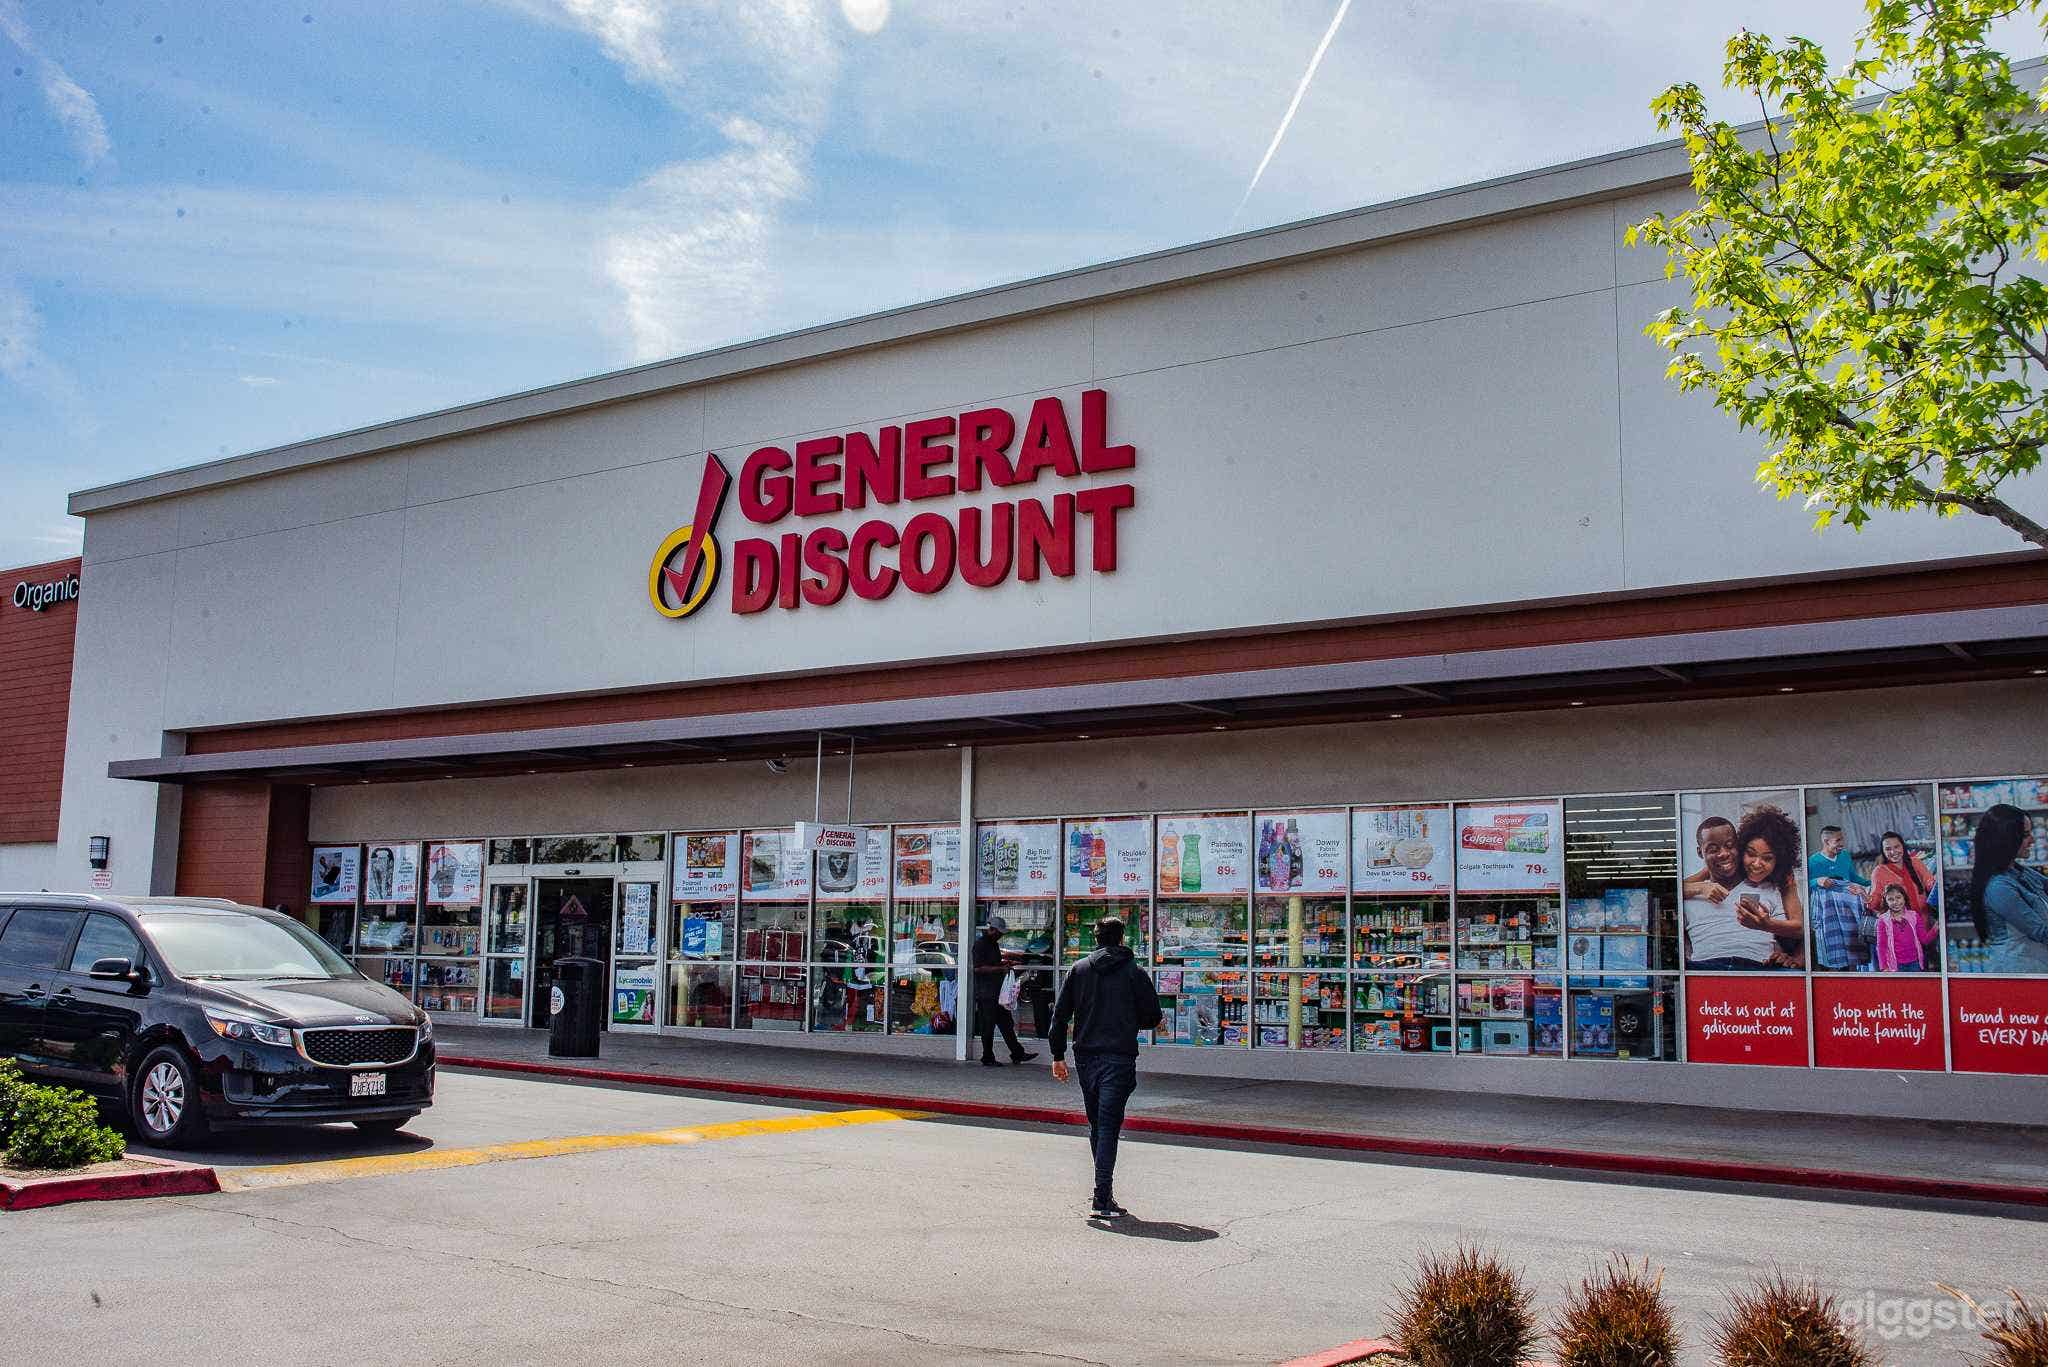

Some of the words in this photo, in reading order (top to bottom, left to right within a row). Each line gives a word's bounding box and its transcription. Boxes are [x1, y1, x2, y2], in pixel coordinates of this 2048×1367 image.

[738, 389, 1135, 524] GENERAL
[732, 484, 1135, 614] DISCOUNT
[13, 573, 79, 612] Organic
[825, 831, 856, 840] GENERAL
[826, 839, 856, 848] DISCOUNT
[1315, 839, 1340, 847] Downy
[1463, 834, 1505, 845] Colgate
[1460, 863, 1480, 871] Colgate
[512, 961, 520, 972] A
[618, 975, 653, 985] Lycamobile
[1699, 1000, 1732, 1016] check
[1736, 1005, 1750, 1018] us
[1753, 1001, 1776, 1017] out
[1780, 1001, 1796, 1018] at
[1833, 1002, 1862, 1025] shop
[1866, 1003, 1896, 1019] with
[1901, 1003, 1925, 1020] the
[1960, 1006, 2004, 1023] brand
[2010, 1014, 2039, 1024] new
[1702, 1018, 1793, 1040] gdiscount.com
[1832, 1021, 1870, 1037] whole
[1874, 1021, 1927, 1045] family!
[1978, 1027, 2028, 1046] EVERY
